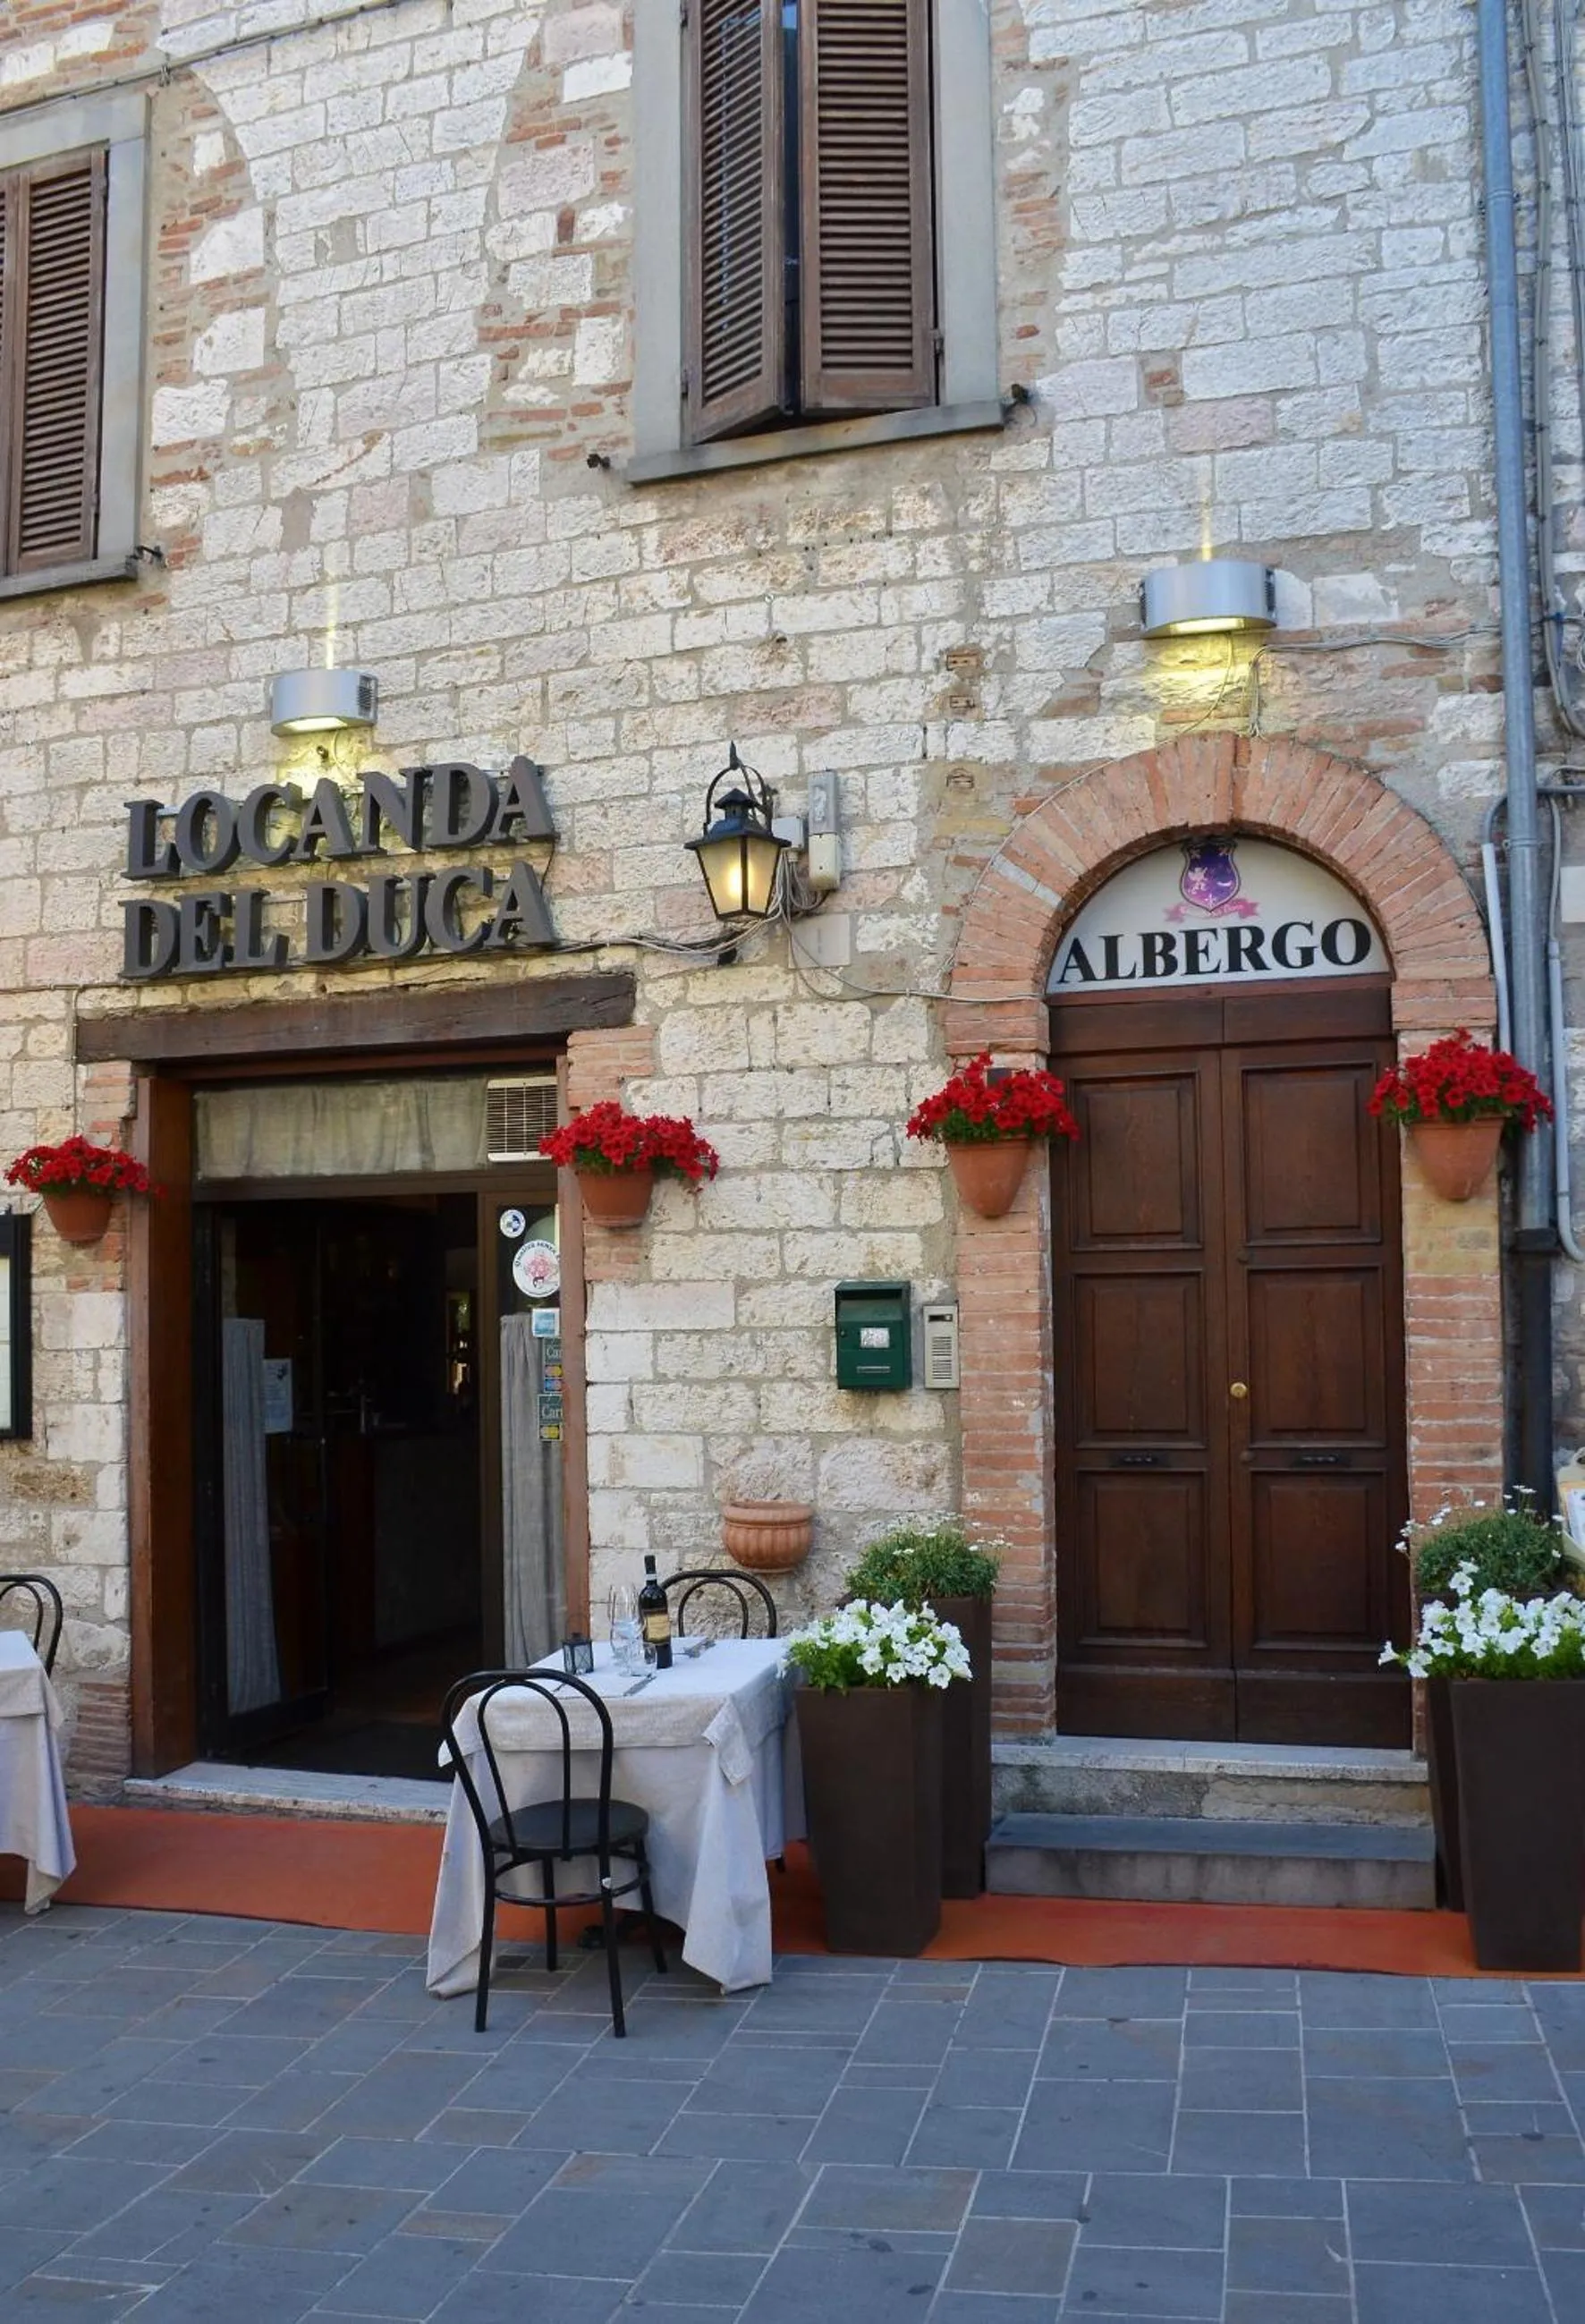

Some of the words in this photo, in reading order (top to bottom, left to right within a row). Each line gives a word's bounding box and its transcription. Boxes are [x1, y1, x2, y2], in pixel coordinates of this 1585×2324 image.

[122, 755, 559, 881] LOCANDA
[118, 886, 289, 980] DEL
[303, 861, 559, 964] DUCA
[1057, 918, 1372, 984] ALBERGO
